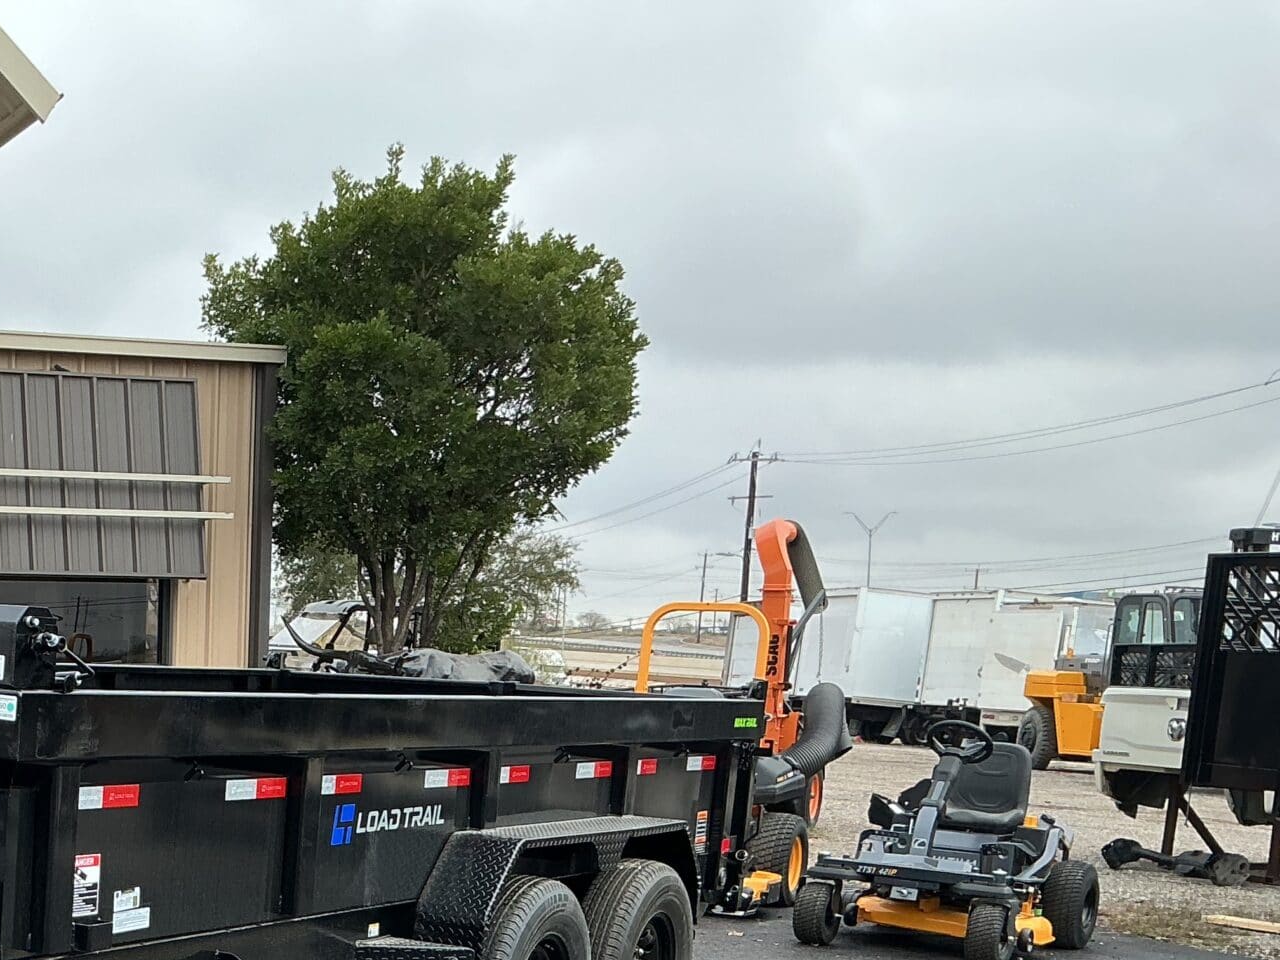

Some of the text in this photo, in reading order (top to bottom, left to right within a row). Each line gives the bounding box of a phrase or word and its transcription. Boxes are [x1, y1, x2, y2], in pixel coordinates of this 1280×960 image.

[766, 634, 779, 676] SCAG
[356, 808, 401, 834] LOAD
[403, 804, 445, 829] TRAIL
